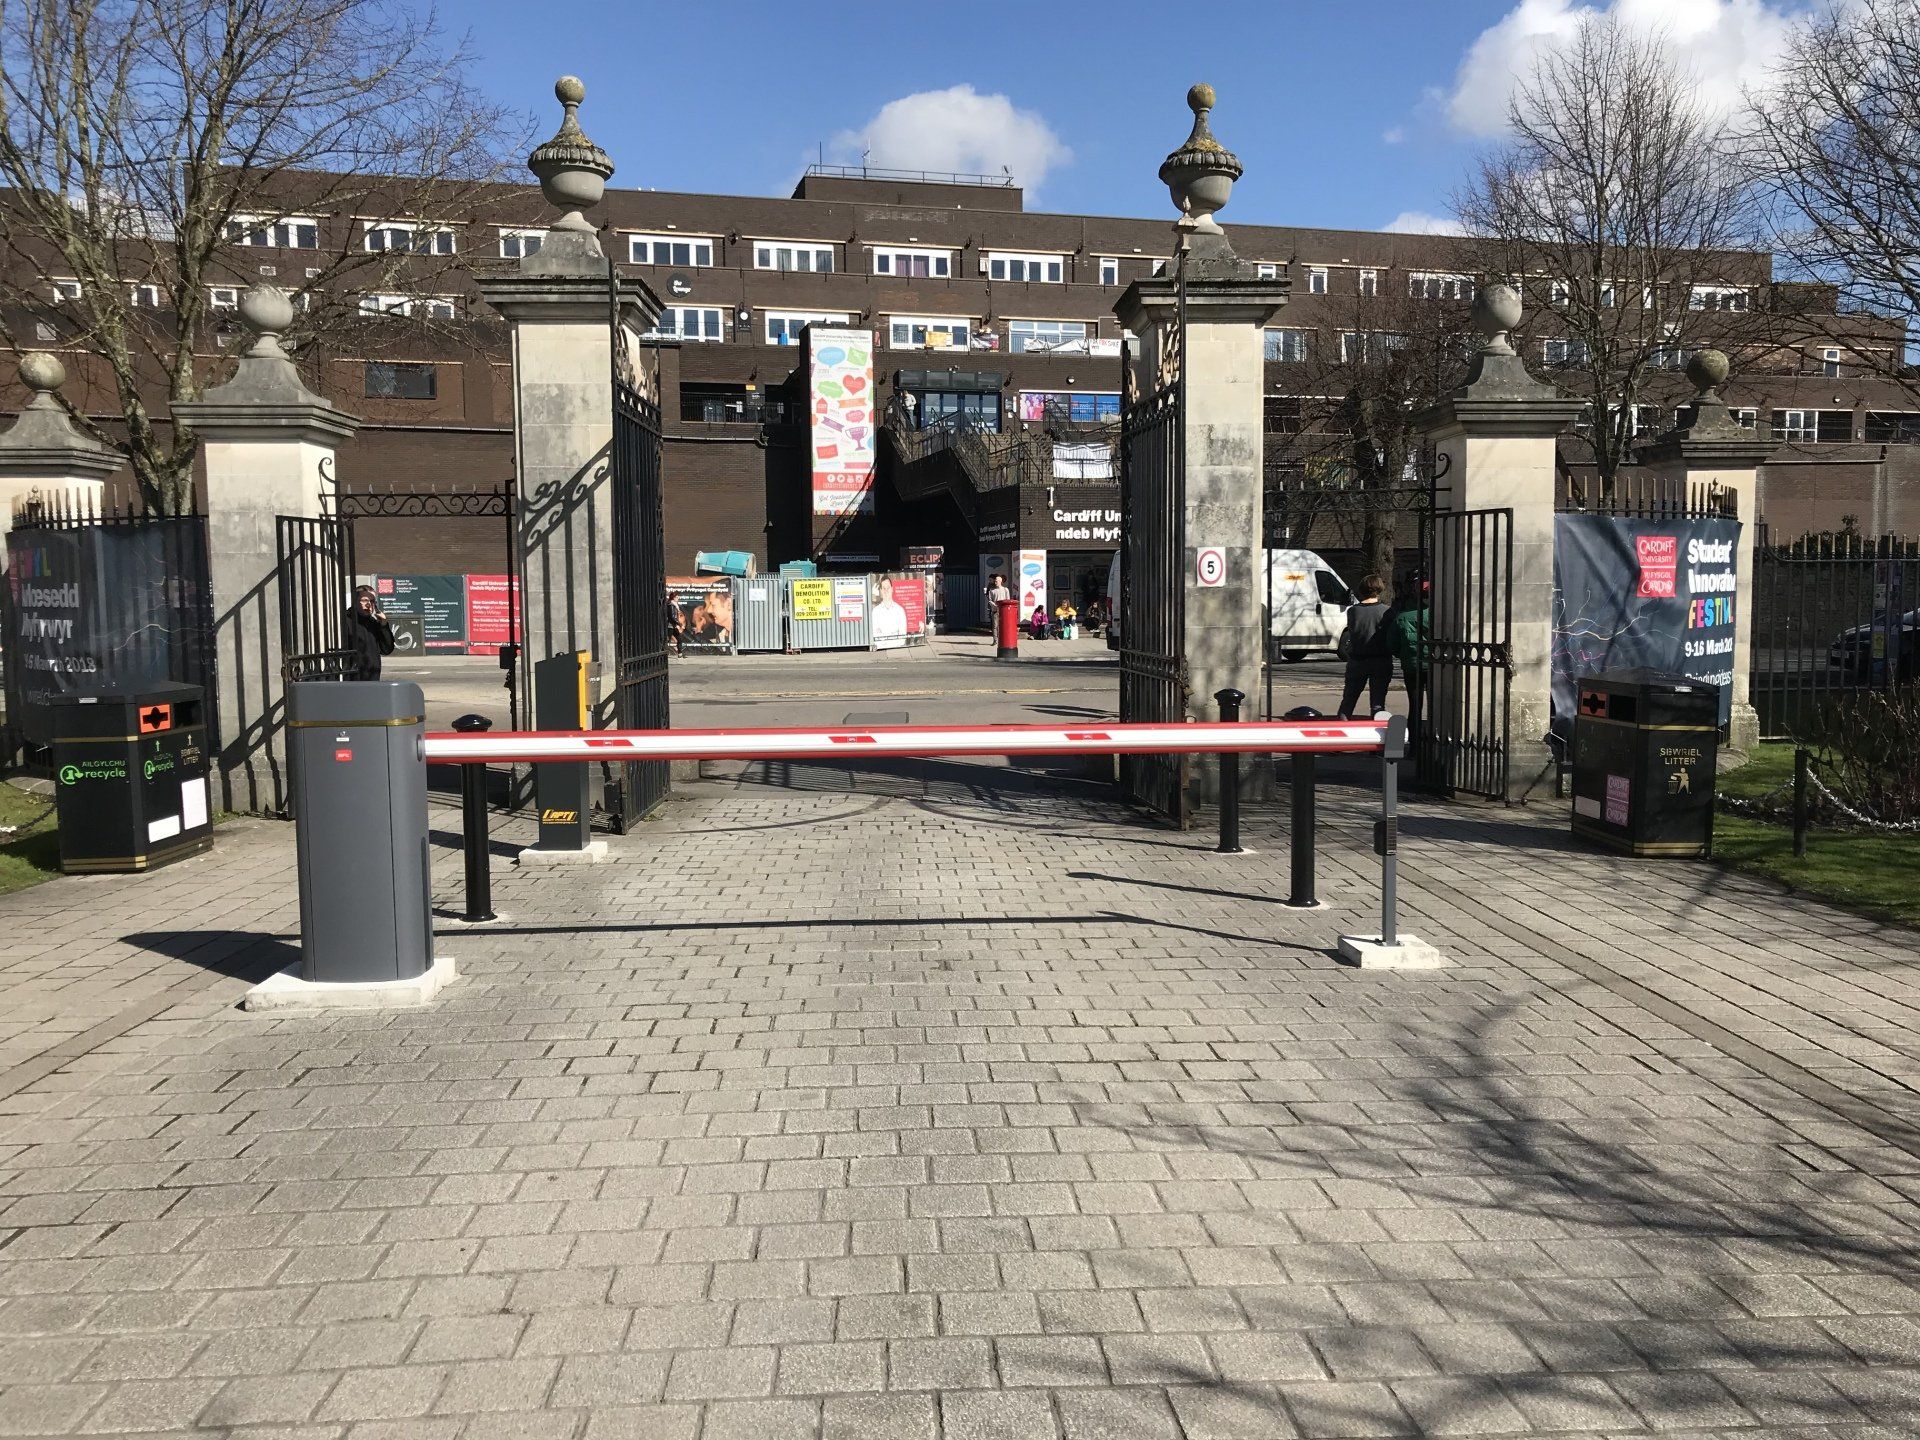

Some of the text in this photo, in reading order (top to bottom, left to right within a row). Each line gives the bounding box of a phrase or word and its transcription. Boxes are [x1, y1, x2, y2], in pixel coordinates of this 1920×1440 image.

[1053, 510, 1102, 522] Cardiff
[1639, 539, 1675, 555] CARDIFF
[1207, 560, 1215, 574] 5
[1685, 641, 1705, 658] 9-16
[1664, 757, 1697, 766] LITTER
[85, 766, 127, 781] recycle
